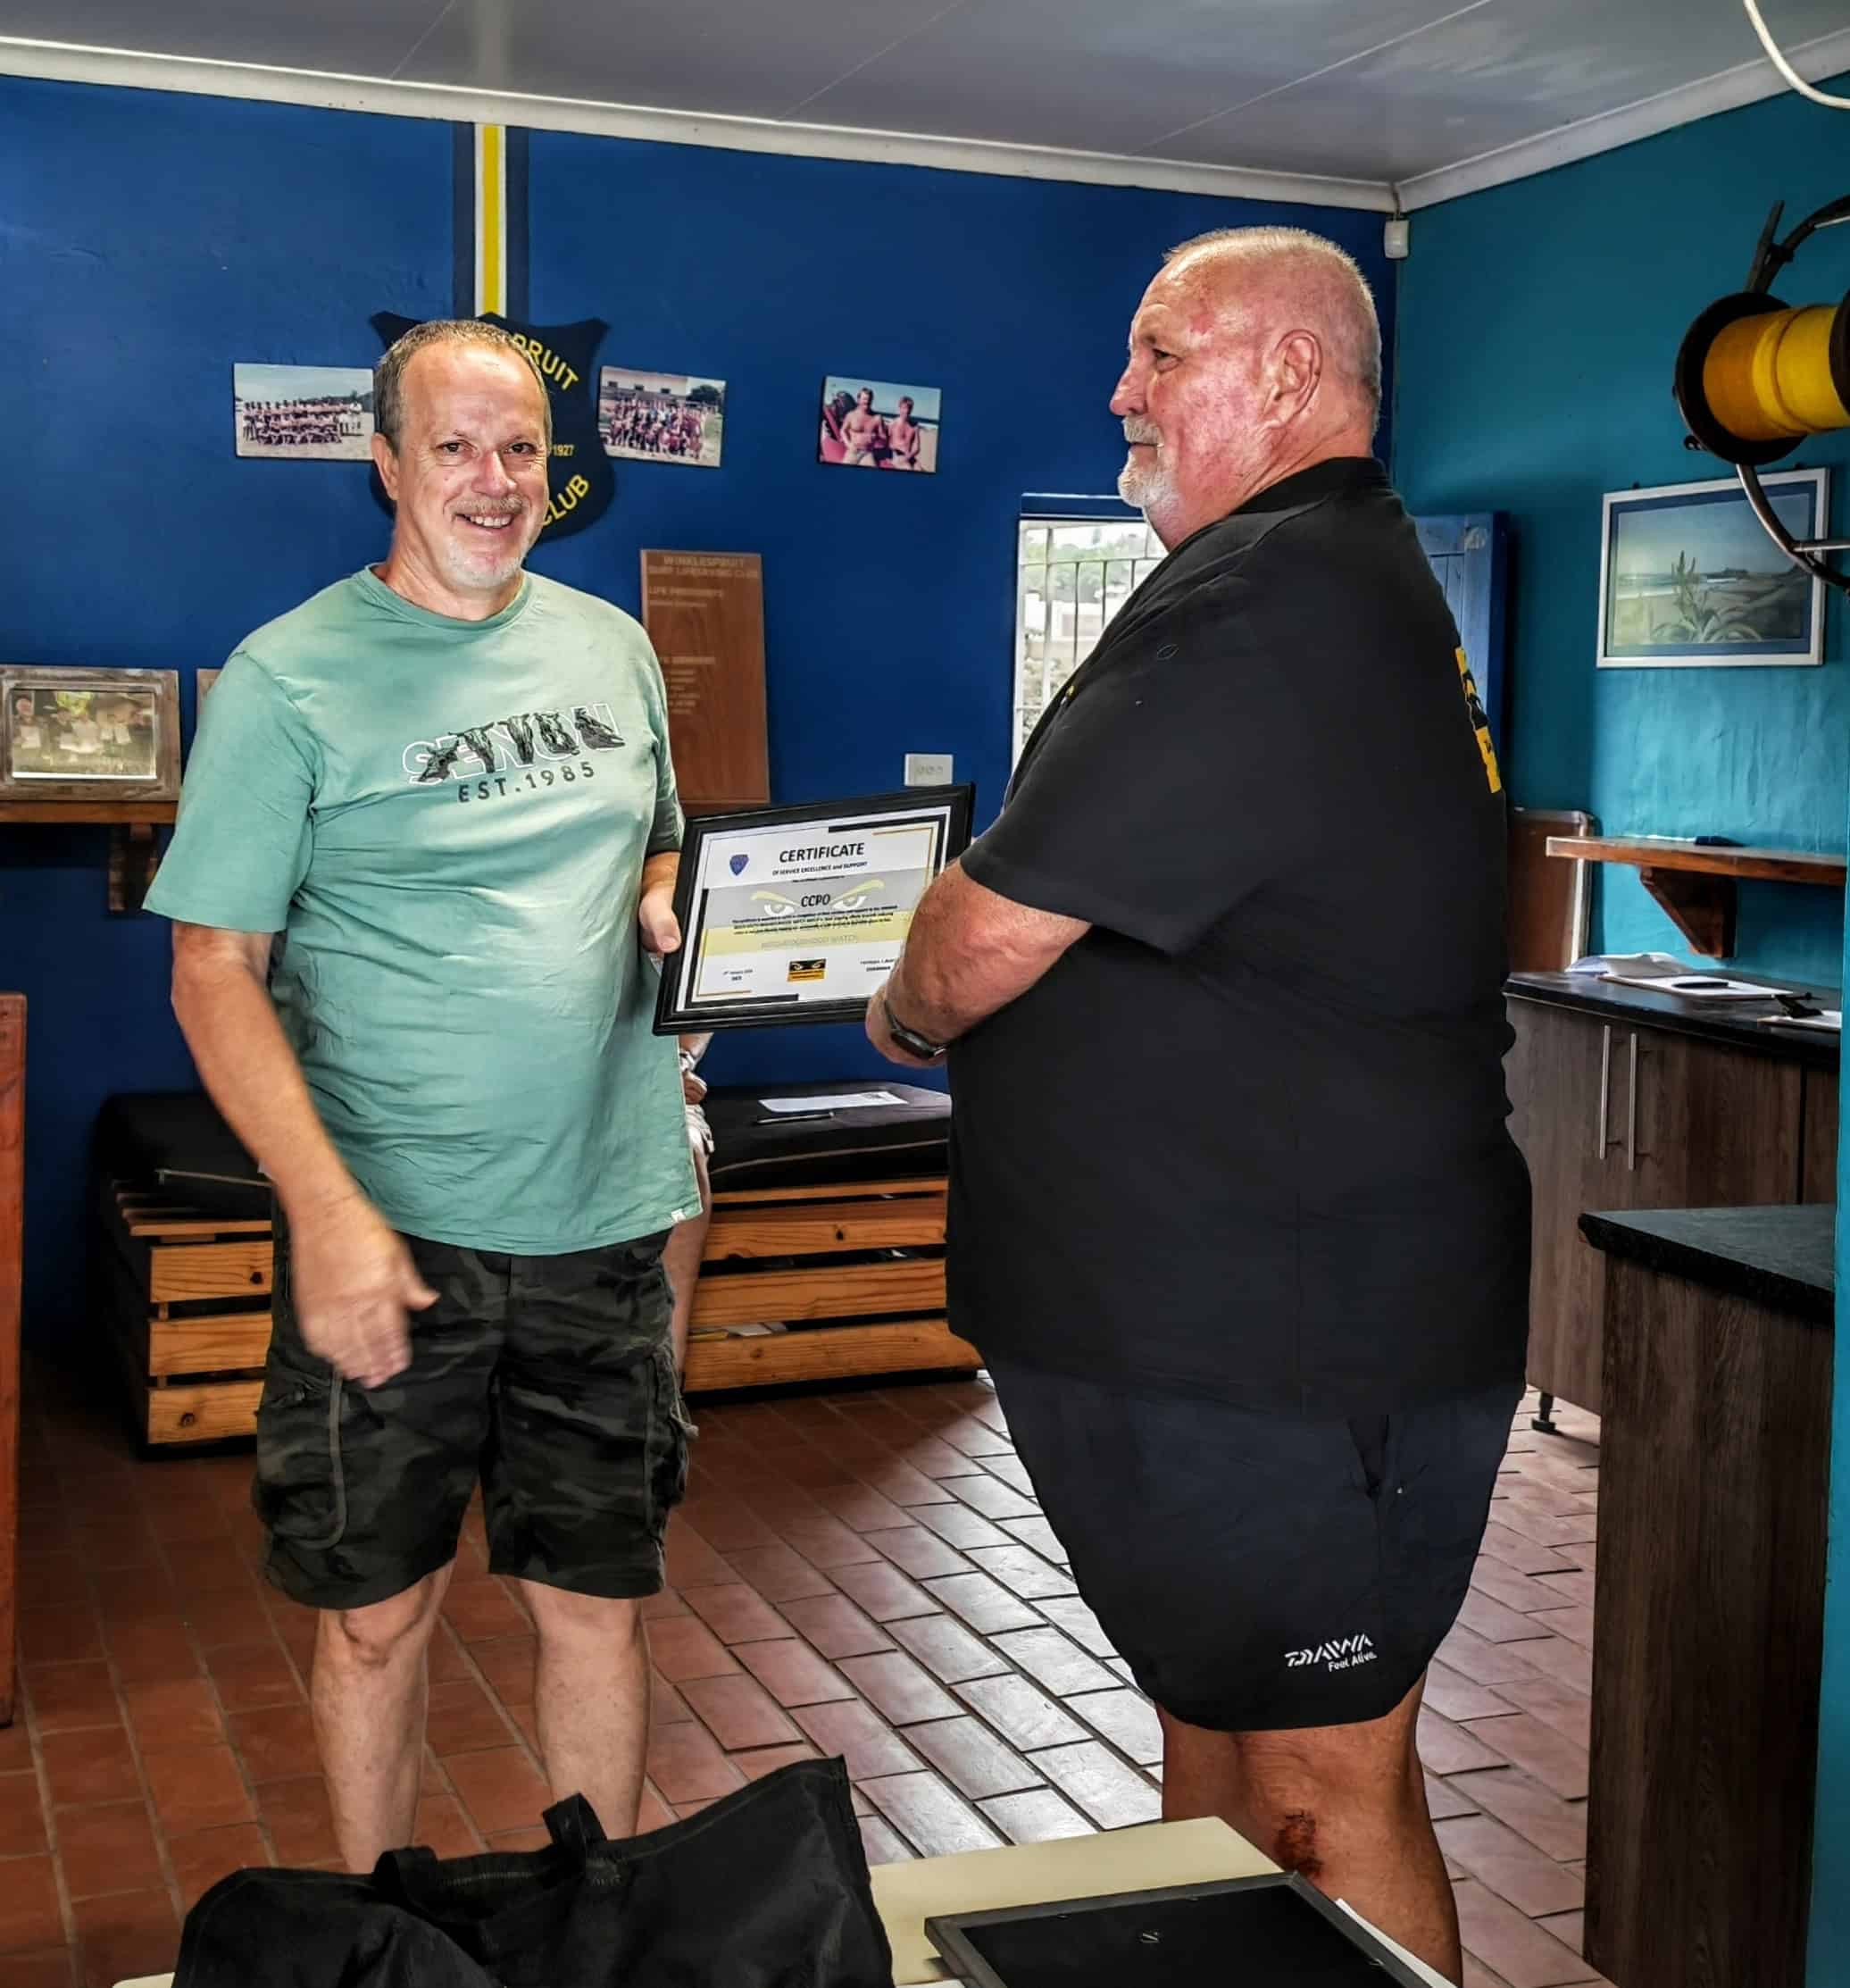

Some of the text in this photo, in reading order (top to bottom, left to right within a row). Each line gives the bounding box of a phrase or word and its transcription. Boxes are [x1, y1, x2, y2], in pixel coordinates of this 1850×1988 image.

[779, 842, 865, 864] CERTIFICATE
[771, 869, 779, 877] OF
[800, 865, 832, 874] EXCELLENCE
[843, 861, 868, 869] SUPPORT
[800, 893, 831, 908] CCPO
[1285, 1633, 1374, 1668] DAIWA
[1328, 1658, 1350, 1673] Feel
